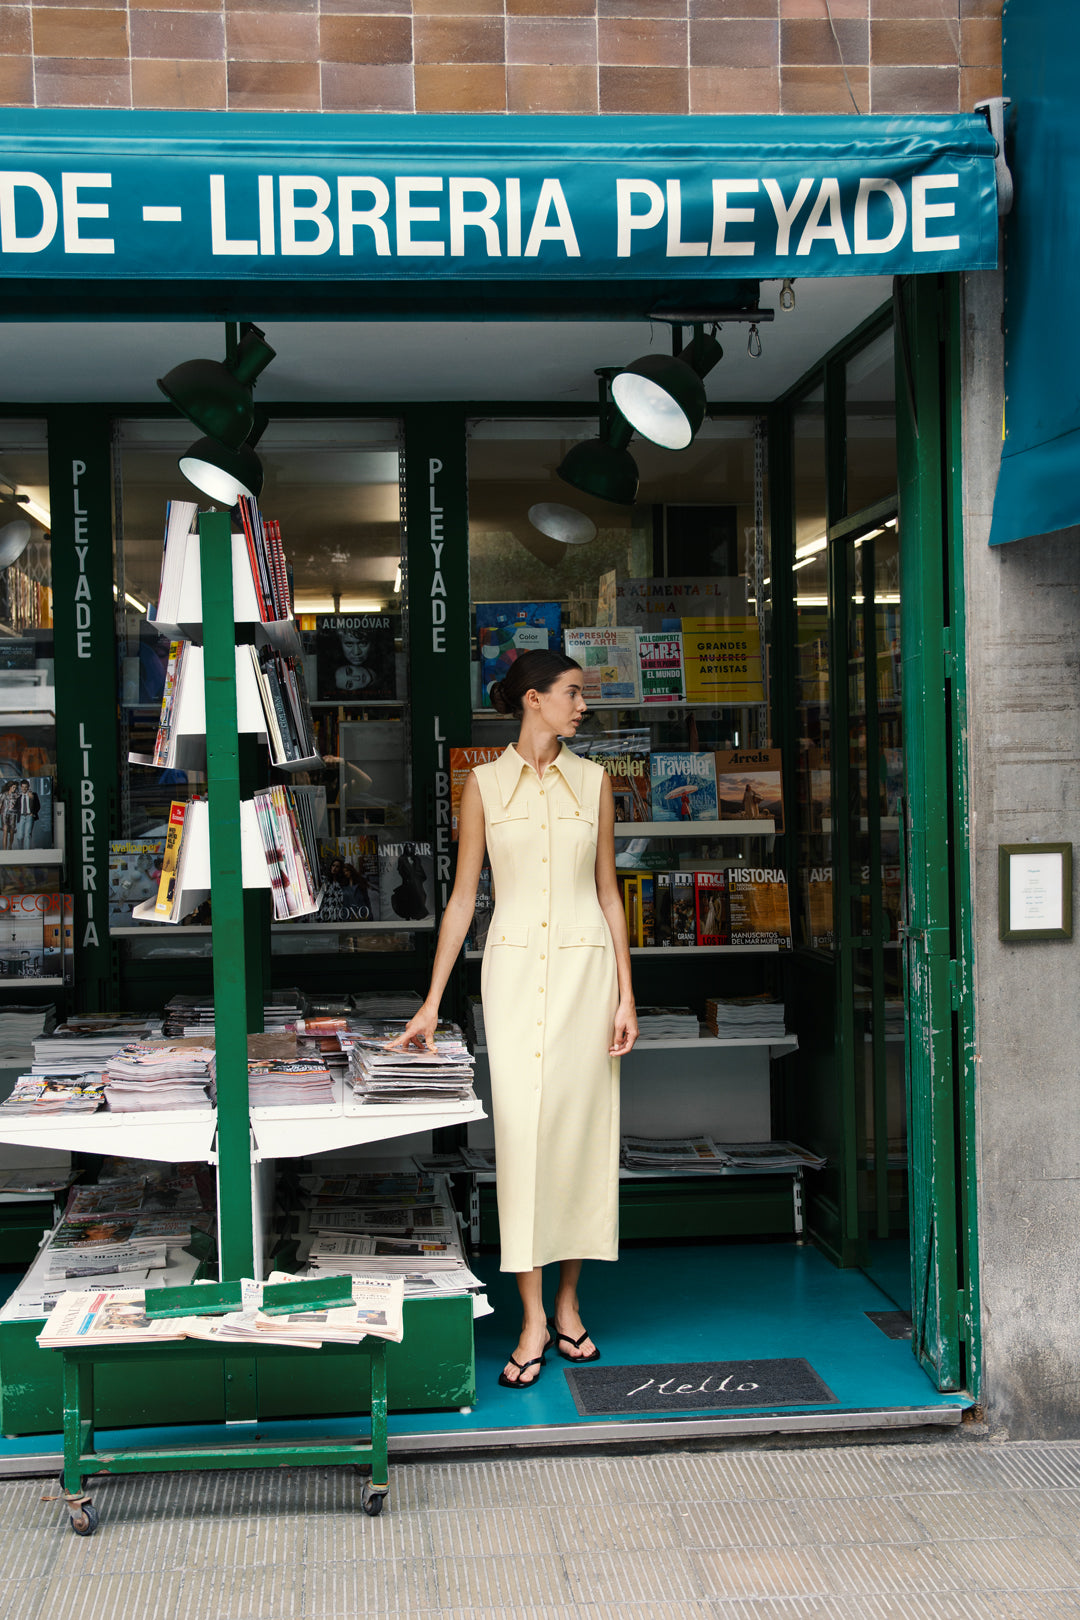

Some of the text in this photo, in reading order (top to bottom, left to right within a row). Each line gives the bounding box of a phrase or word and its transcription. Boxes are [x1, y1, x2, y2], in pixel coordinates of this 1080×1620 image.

[209, 174, 581, 258] LIBRERIA
[616, 173, 961, 258] PLEYADE
[72, 460, 92, 659] PLEYADE
[428, 458, 447, 653] PLEYADE
[630, 584, 700, 597] ALIMENTA
[705, 583, 721, 596] EL
[635, 601, 676, 613] ALMA
[322, 614, 391, 630] ALMODÓVAR
[697, 641, 747, 650] GRANDES
[699, 653, 747, 662] MUJERES
[647, 669, 681, 679] EL MUNDO
[700, 665, 748, 674] ARTISTAS
[463, 750, 505, 763] VIAJA
[728, 752, 770, 764] Arrels
[653, 755, 711, 776] Traveller
[434, 715, 452, 920] LIBRERI
[79, 723, 100, 948] LIBRERIA
[728, 868, 786, 883] HISTORIA
[626, 1373, 759, 1397] Hello
